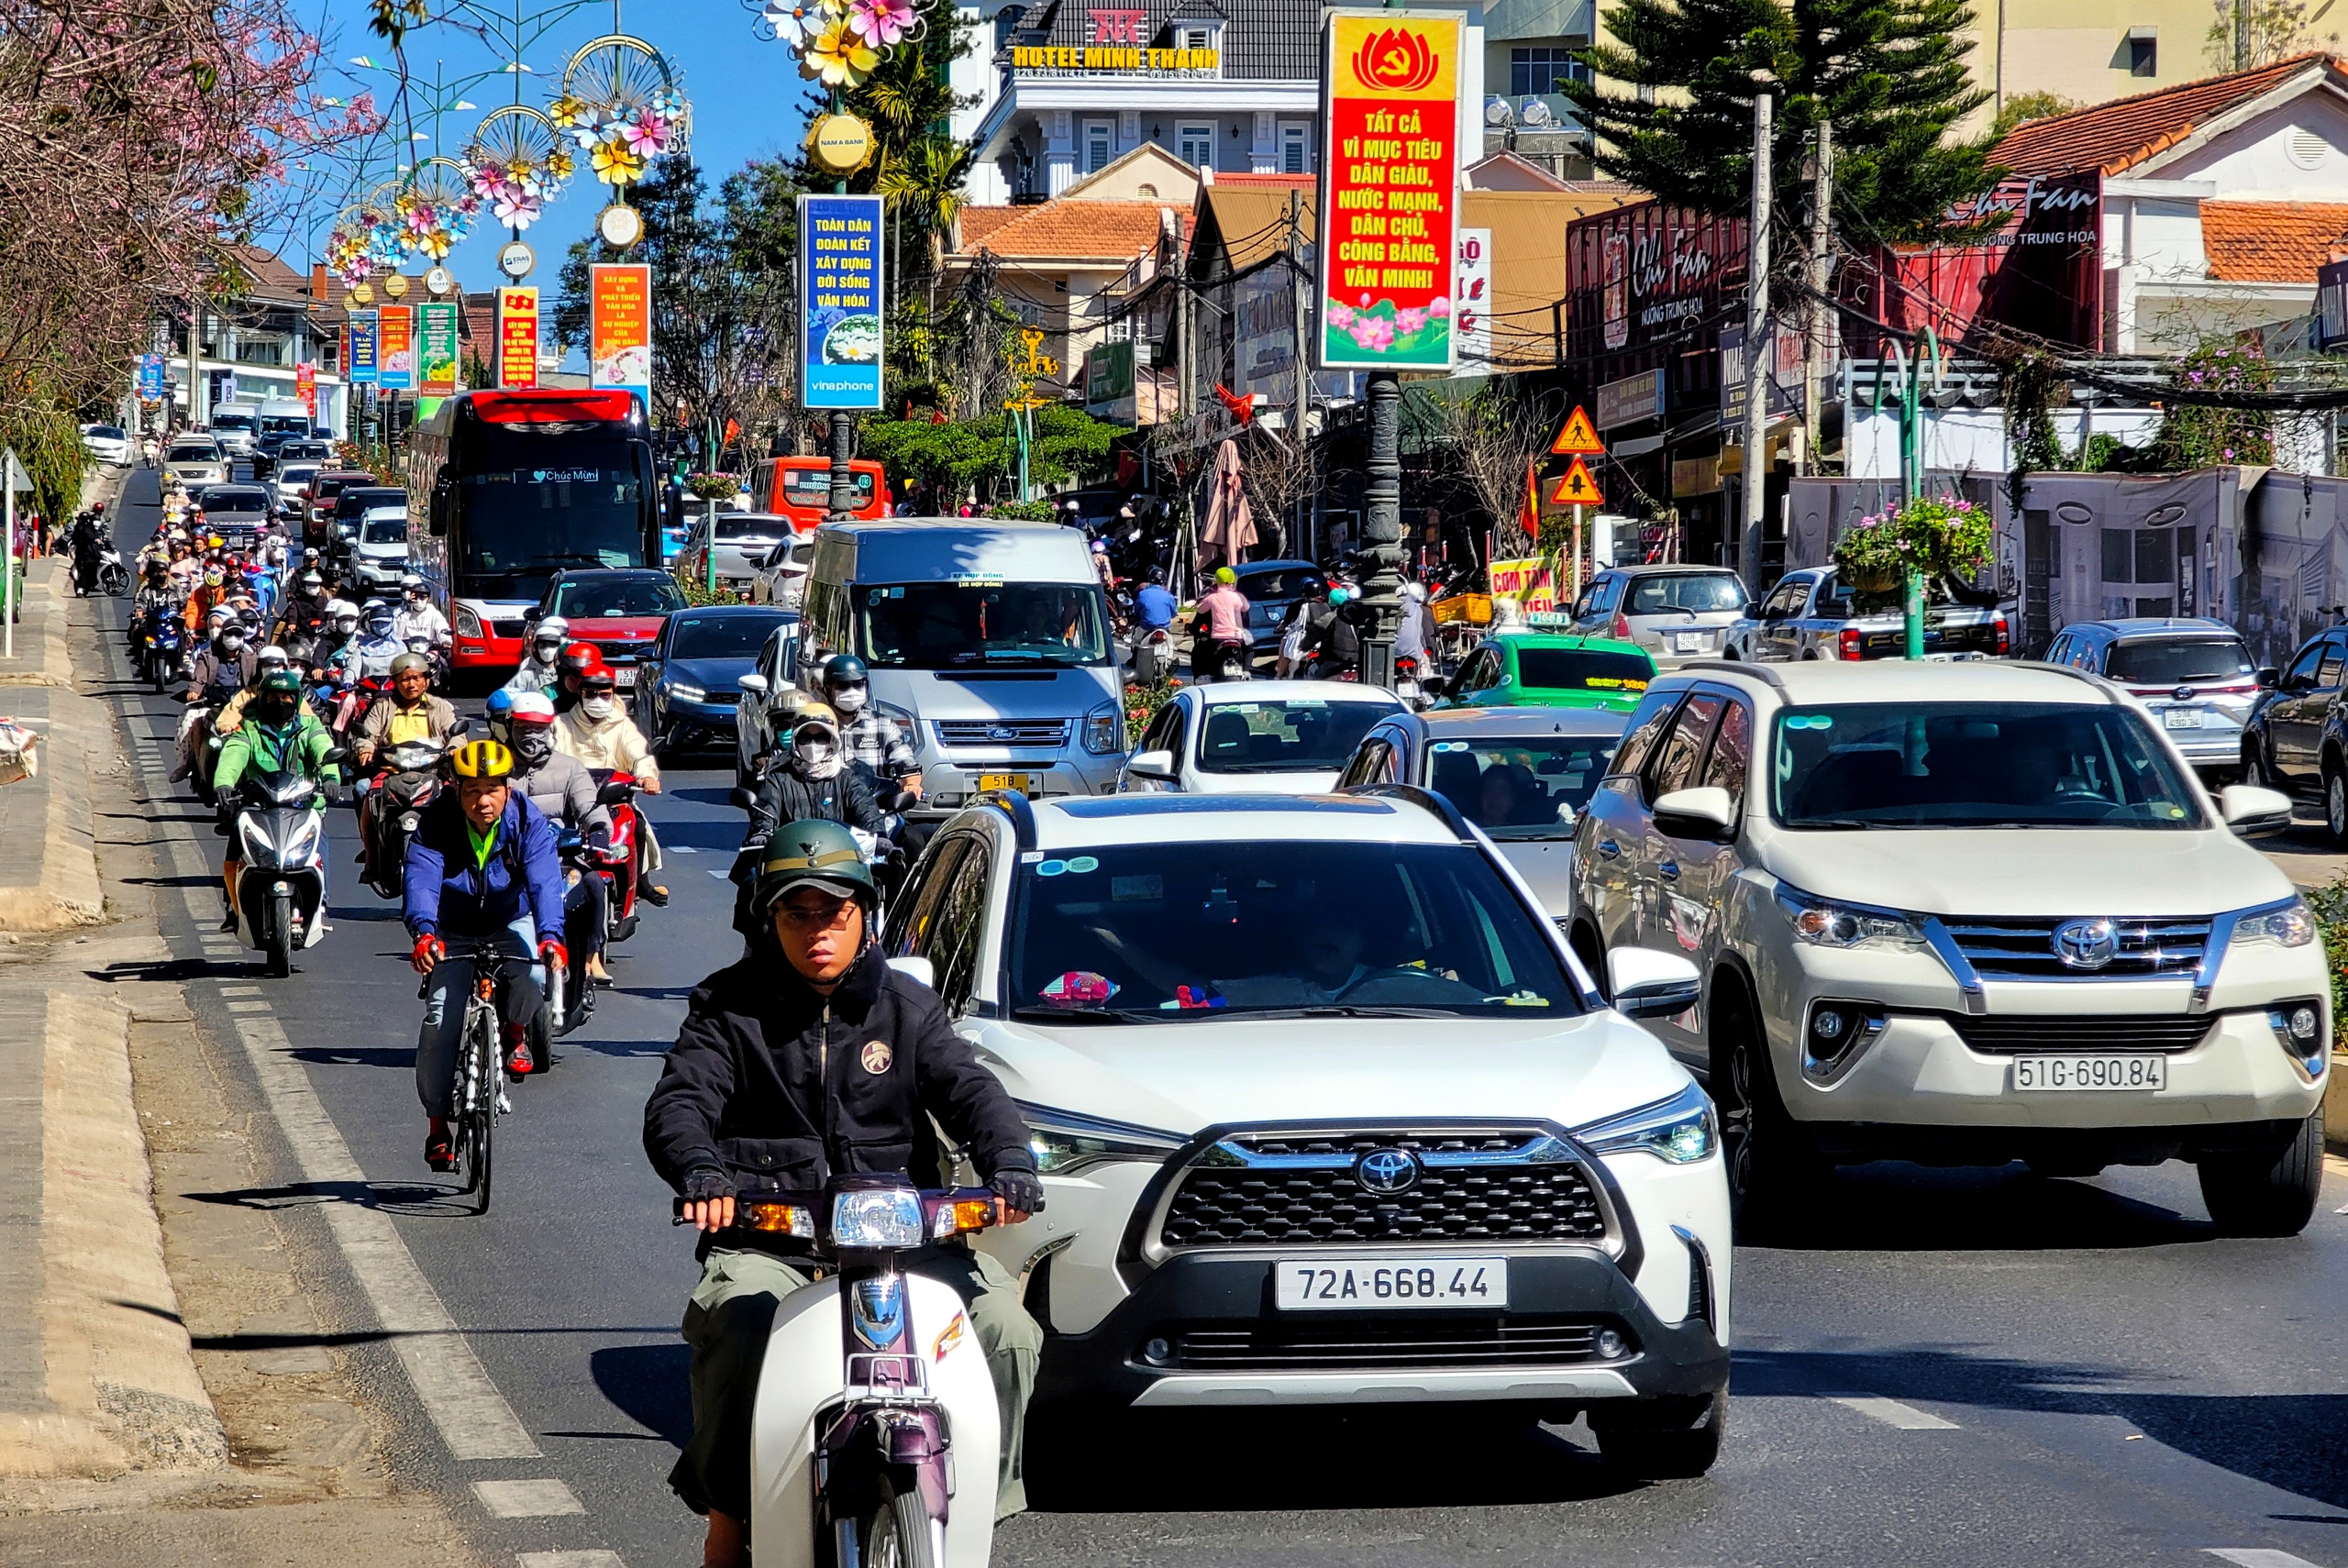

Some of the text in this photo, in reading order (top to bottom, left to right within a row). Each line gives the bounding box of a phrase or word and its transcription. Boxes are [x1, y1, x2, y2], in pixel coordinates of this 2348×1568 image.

[1013, 46, 1219, 69] HOTEL MINH THANH
[1365, 108, 1422, 133] TẤT CẢ
[1344, 138, 1442, 162] VÌ MỤC TIÊU
[1350, 162, 1433, 187] DÂN GIÀU,
[1339, 187, 1444, 214] NƯỚC MẠNH,
[2023, 174, 2099, 219] Fan
[815, 215, 871, 232] TOÀN DÂN
[1351, 213, 1428, 238] DÂN CHỦ,
[815, 235, 871, 251] ĐOÀN KẾT
[2020, 231, 2064, 245] TRUNG
[2067, 230, 2097, 243] HOA
[1339, 237, 1439, 265] CÔNG BẰNG,
[815, 255, 871, 272] XÂY DỰNG
[816, 272, 870, 288] ĐỜI SỐNG
[1345, 265, 1433, 288] VĂN MINH!
[816, 292, 869, 307] VĂN HÓA!
[1665, 299, 1688, 321] TRUNG
[1689, 296, 1703, 315] HOA
[811, 380, 874, 393] vinaphone
[546, 468, 571, 480] Chúc
[1493, 561, 1551, 592] CƠM TẤM
[993, 729, 1013, 738] Ford
[2019, 1059, 2159, 1087] 51G-690.84
[1298, 1267, 1488, 1299] 72A-668.44
